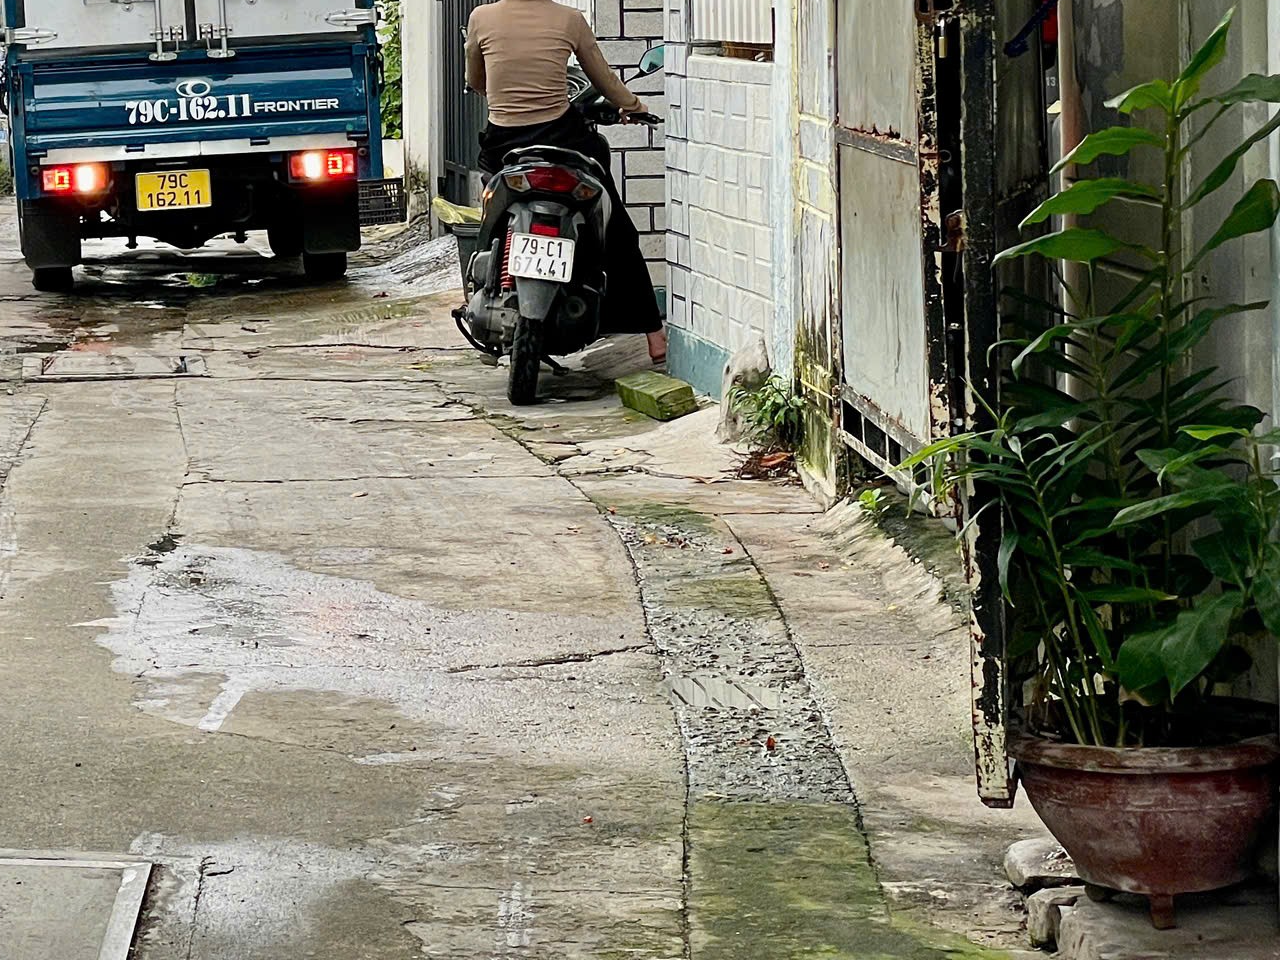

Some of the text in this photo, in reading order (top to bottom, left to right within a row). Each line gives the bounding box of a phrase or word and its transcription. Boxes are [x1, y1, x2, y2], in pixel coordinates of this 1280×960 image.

[125, 94, 252, 125] 79C-162.11
[253, 98, 339, 113] FRONTIER
[157, 174, 188, 190] 79C
[147, 190, 201, 208] 162.11
[521, 238, 563, 258] 79-C1
